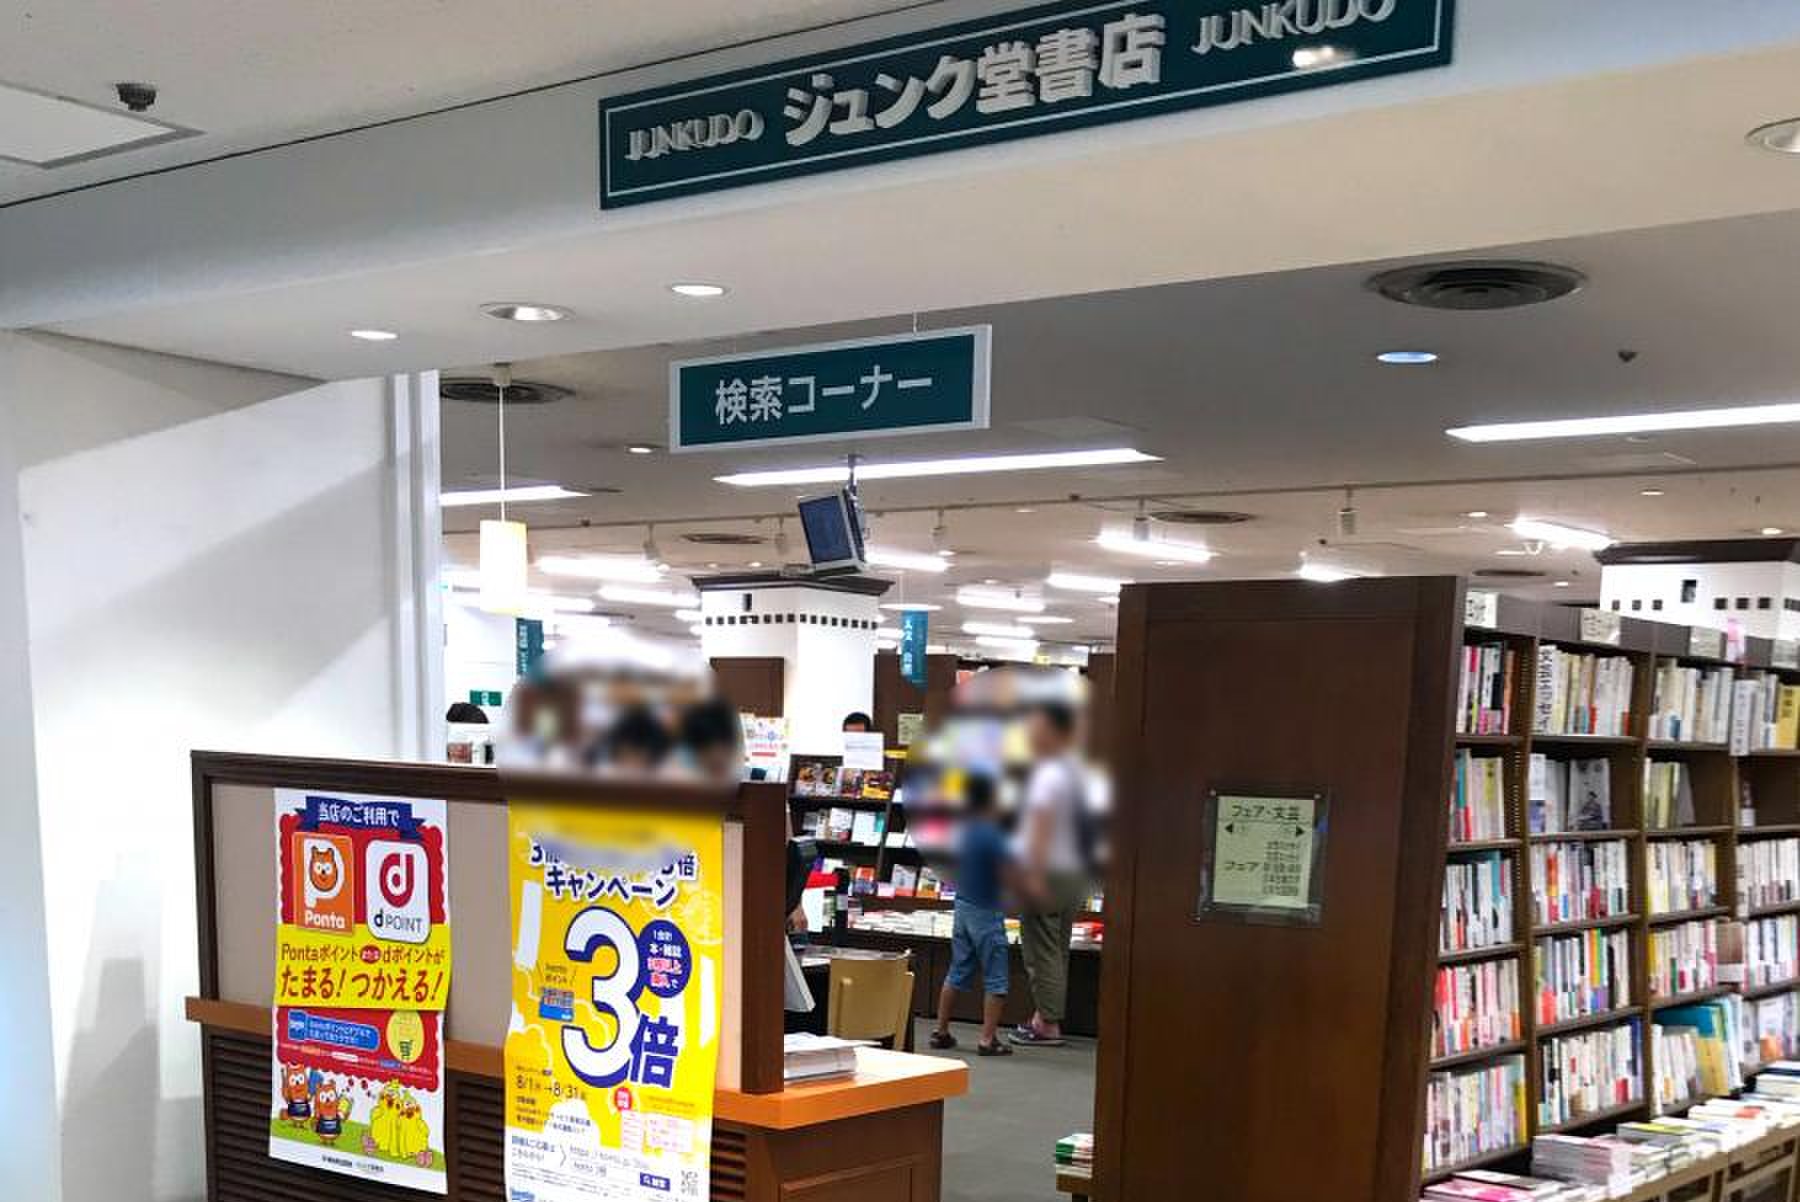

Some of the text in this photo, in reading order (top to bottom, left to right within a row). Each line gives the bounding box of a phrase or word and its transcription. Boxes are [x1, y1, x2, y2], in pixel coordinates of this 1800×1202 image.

[625, 109, 765, 160] JUNKUDO
[783, 14, 1166, 146] ジュンク堂書店
[714, 364, 933, 424] 検索コーナー
[319, 802, 400, 826] 当店のご利用で
[304, 910, 345, 929] Ponta
